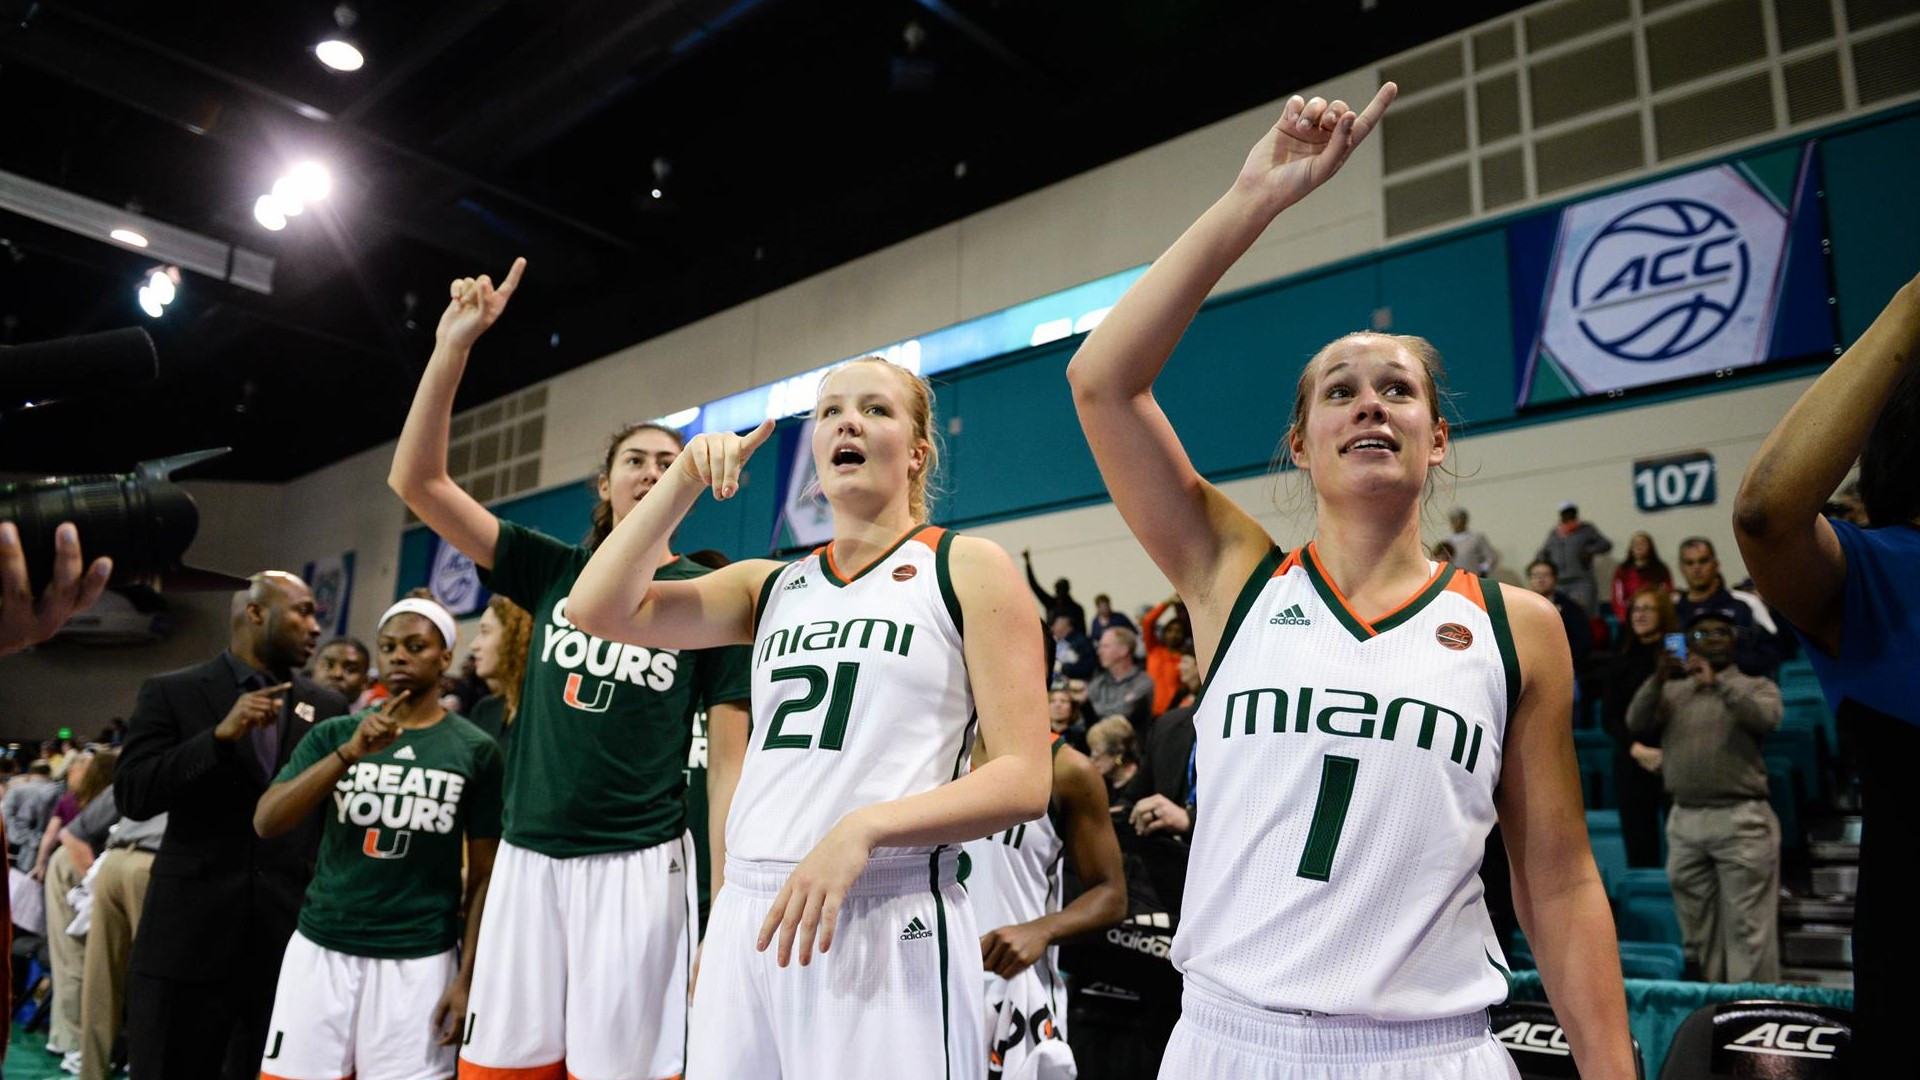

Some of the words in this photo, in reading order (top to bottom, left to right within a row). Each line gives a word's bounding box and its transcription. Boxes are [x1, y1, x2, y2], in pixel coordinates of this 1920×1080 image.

[1592, 233, 1740, 300] ACC
[1636, 461, 1710, 507] 107
[1269, 616, 1311, 627] adidas
[541, 624, 677, 692] YOURS
[563, 672, 615, 713] U
[762, 661, 860, 751] 21
[335, 762, 466, 803] CREATE
[332, 790, 457, 834] YOURS
[1296, 754, 1360, 882] 1
[362, 828, 412, 859] U
[900, 930, 933, 941] adidas
[1106, 928, 1171, 960] adida
[1495, 1021, 1570, 1050] ACC
[1733, 1022, 1846, 1052] ACC
